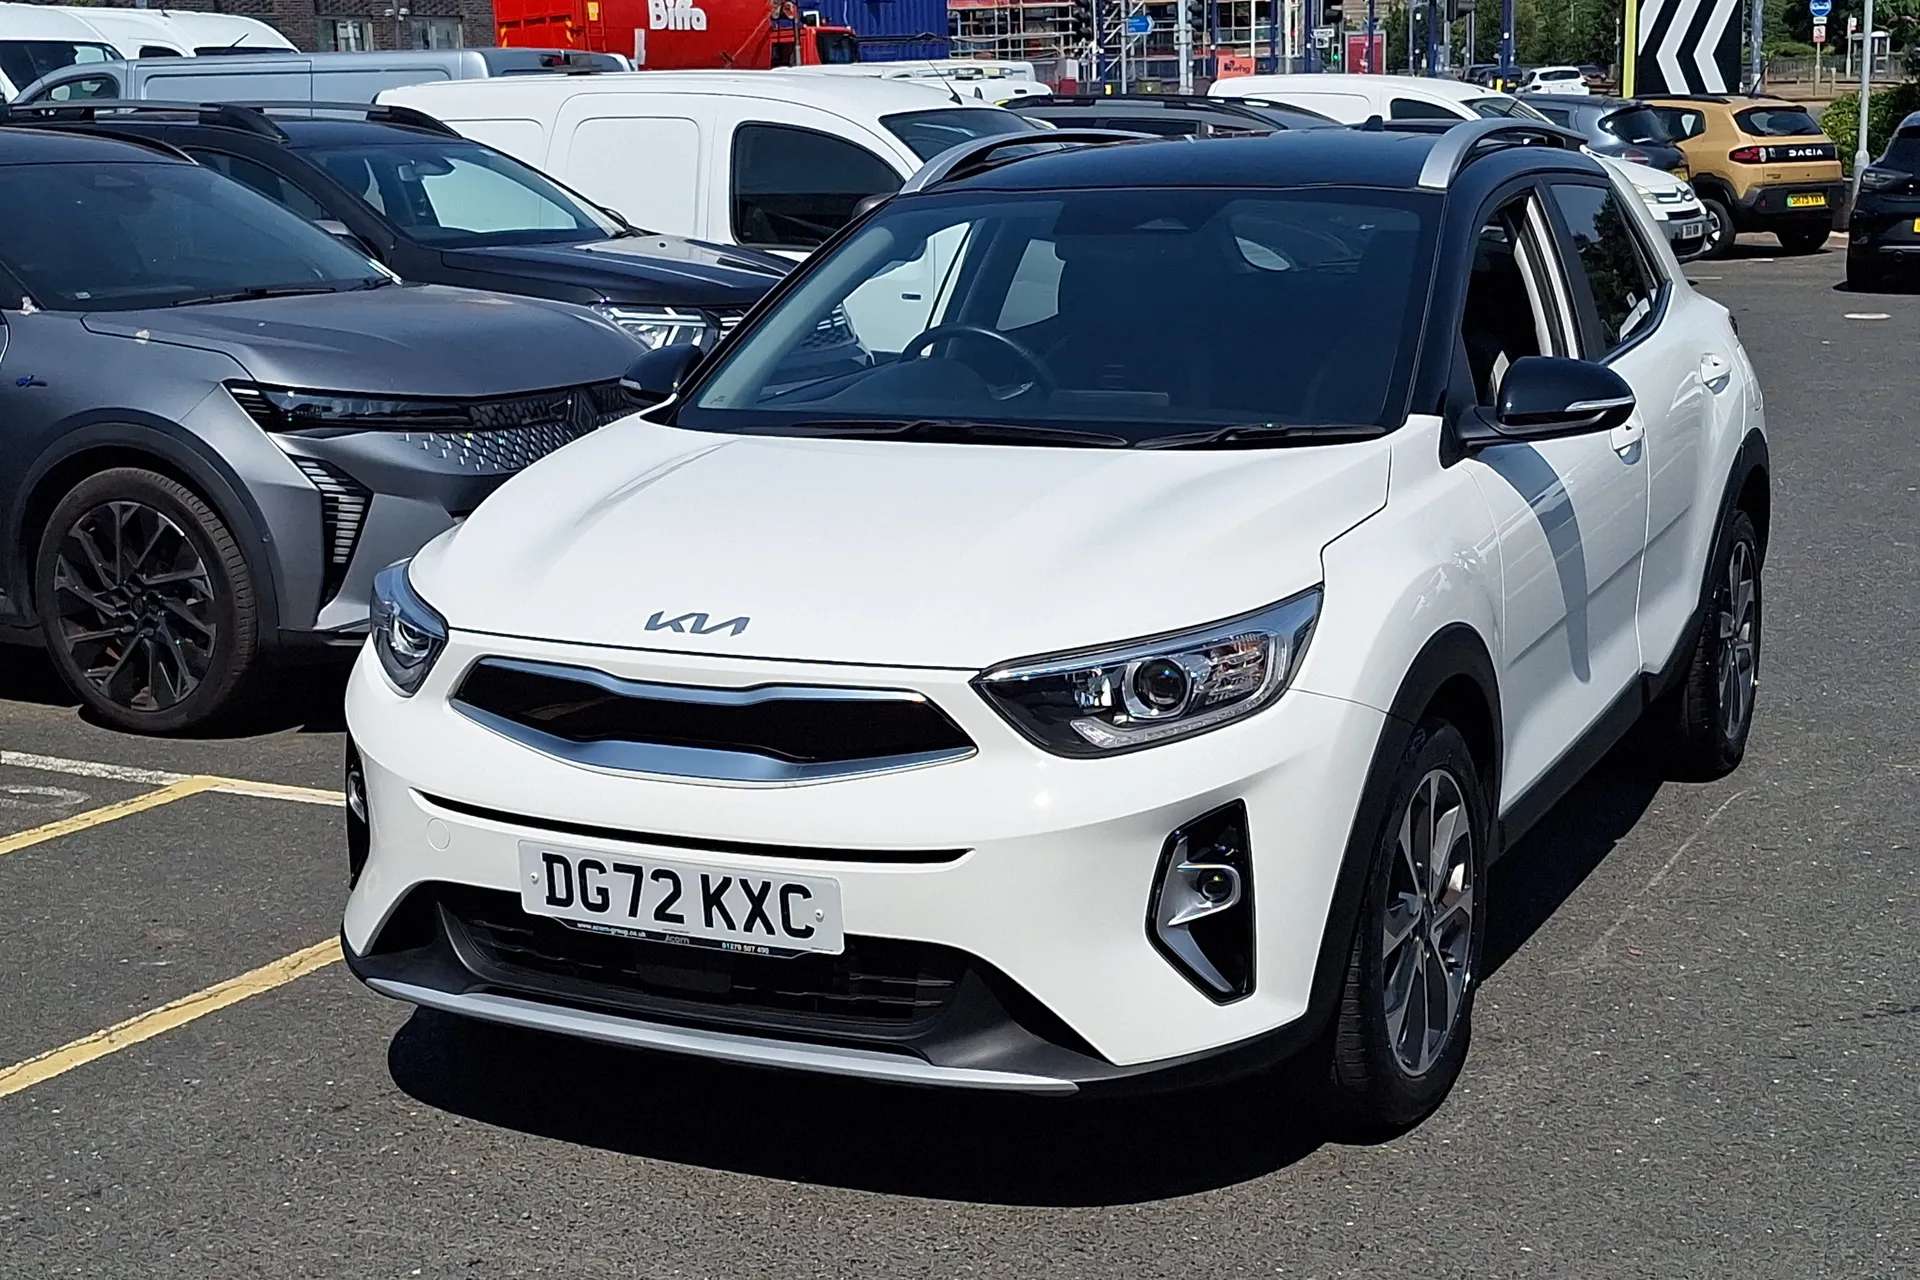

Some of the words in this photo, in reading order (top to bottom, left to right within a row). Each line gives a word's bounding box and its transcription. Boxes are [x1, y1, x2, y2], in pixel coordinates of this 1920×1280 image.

[648, 0, 707, 31] Biffa
[1788, 148, 1824, 157] DACIA
[644, 610, 751, 637] KIA
[541, 852, 686, 925] DG72
[700, 873, 815, 939] KXC
